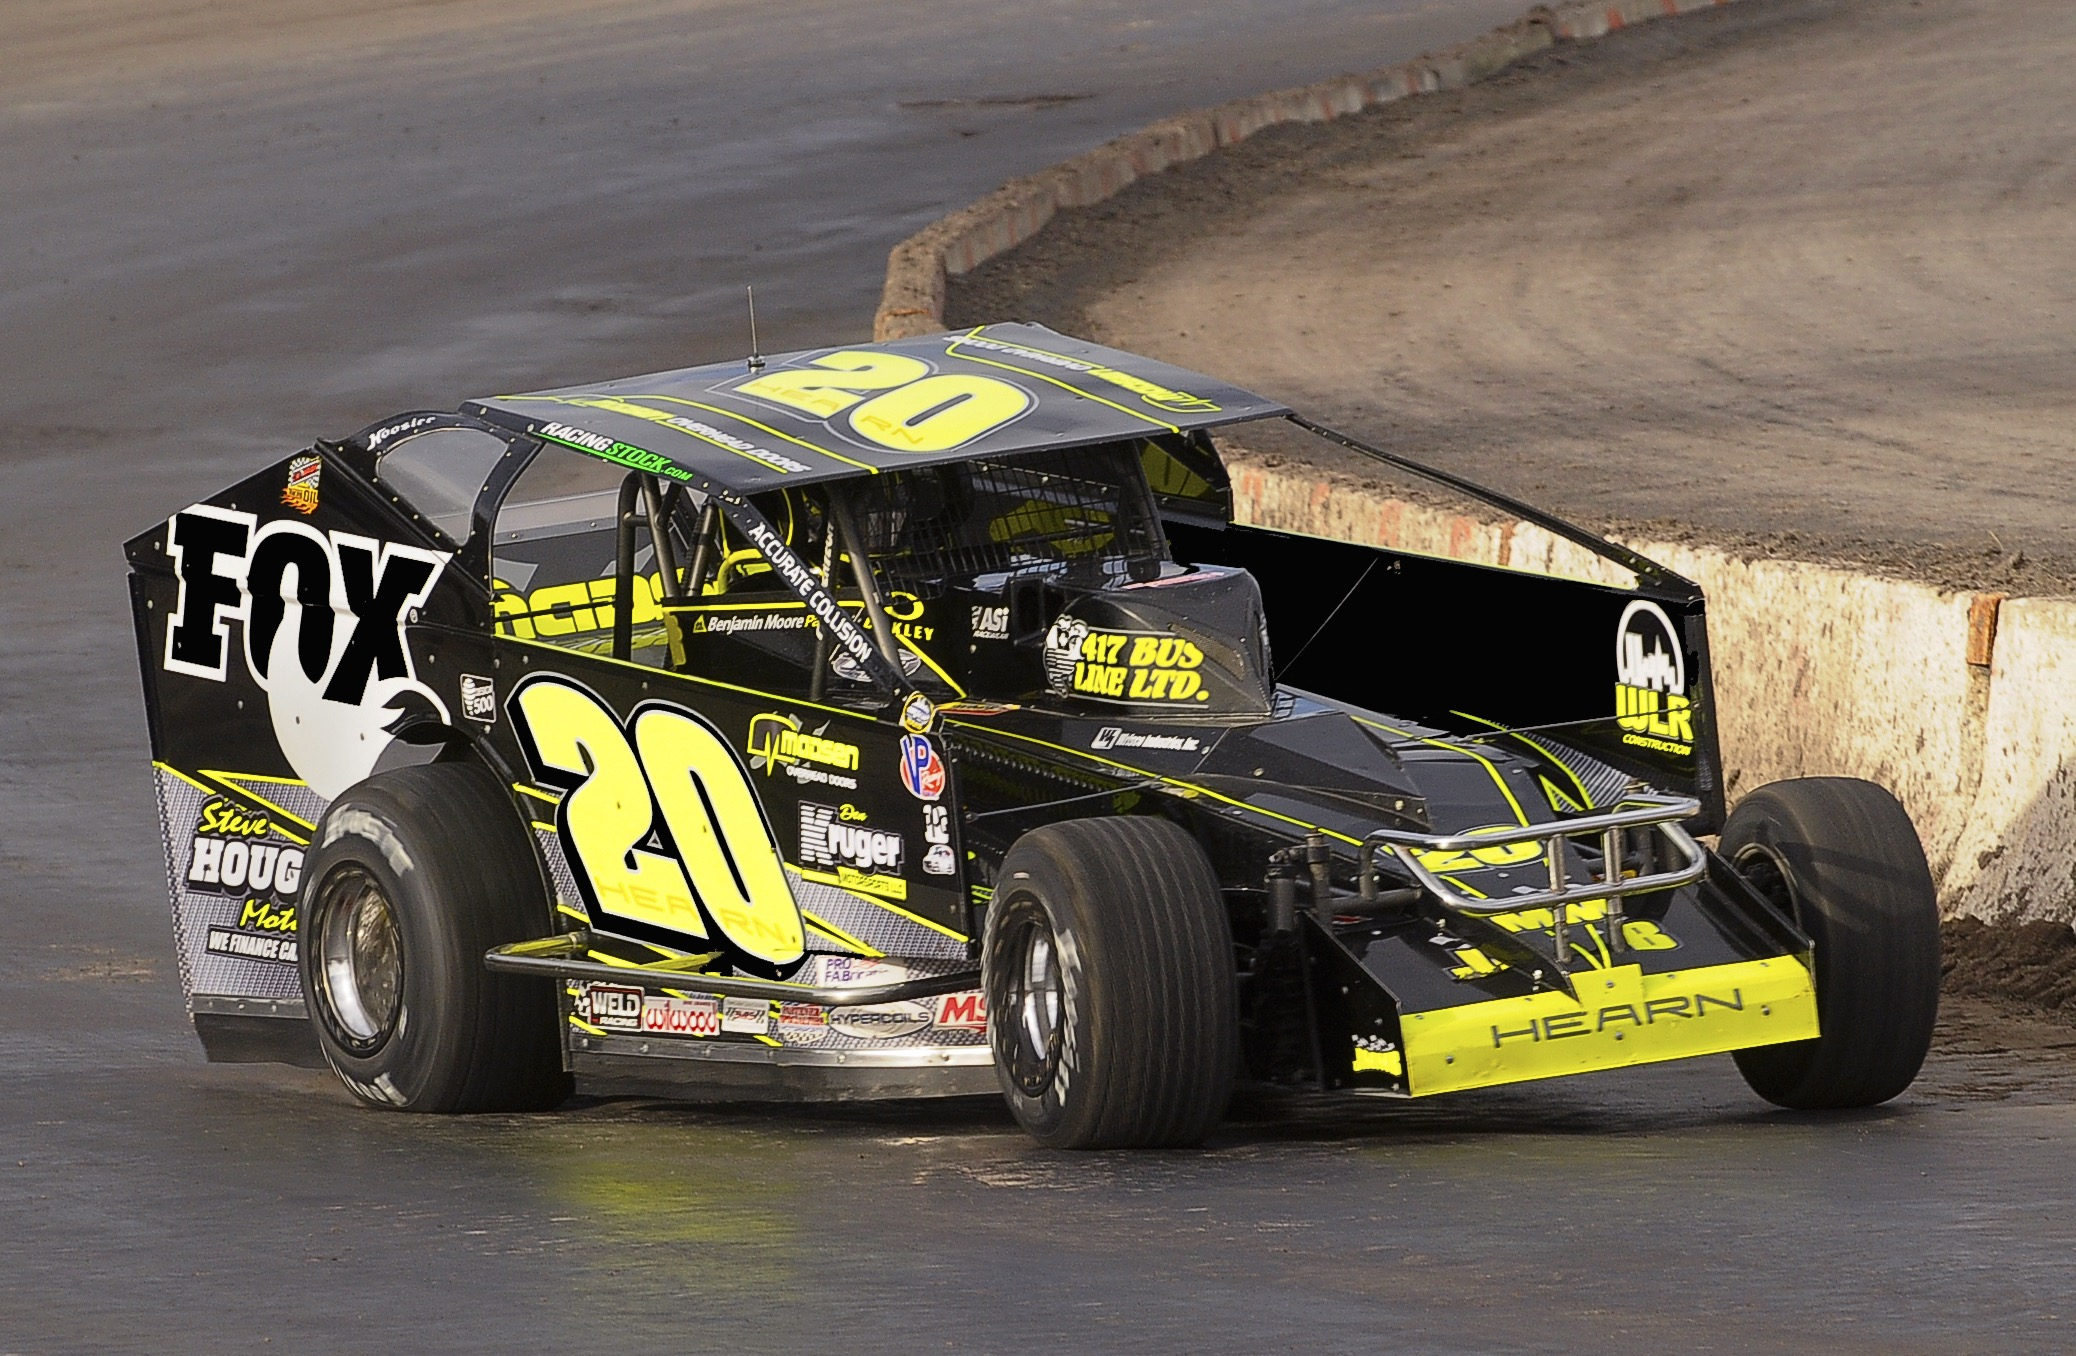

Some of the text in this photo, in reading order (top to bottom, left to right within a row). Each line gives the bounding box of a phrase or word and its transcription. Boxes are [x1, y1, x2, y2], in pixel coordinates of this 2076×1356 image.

[731, 350, 1030, 452] 20
[163, 503, 453, 706] FOX
[748, 523, 873, 663] ACCURATE COLLISION
[708, 615, 759, 635] Benjamin
[764, 613, 804, 630] Moore
[1081, 634, 1205, 668] 417 BUS
[1073, 664, 1210, 701] LINE LTD.
[1622, 733, 1692, 756] CONSTRUCTION
[903, 735, 930, 795] VP
[199, 801, 267, 836] Steve
[505, 671, 805, 981] 20
[594, 876, 788, 946] HEARN
[208, 930, 231, 951] WE
[228, 934, 280, 959] FINANCE
[826, 958, 852, 970] PRO
[590, 992, 641, 1017] WELD
[599, 1016, 639, 1027] RACING
[830, 1012, 931, 1026] HYPERCOILS
[1490, 988, 1744, 1049] HEARN
